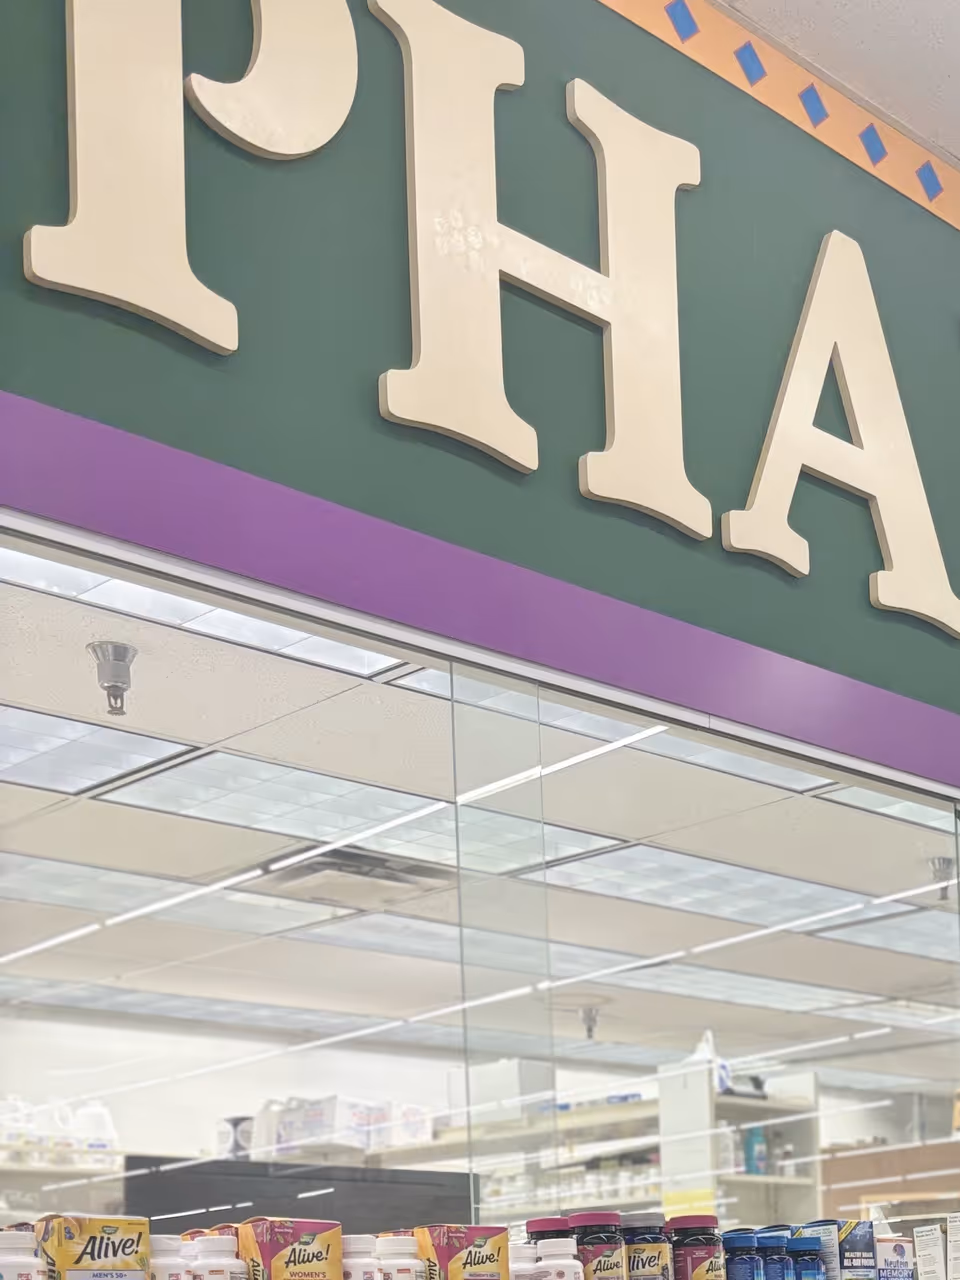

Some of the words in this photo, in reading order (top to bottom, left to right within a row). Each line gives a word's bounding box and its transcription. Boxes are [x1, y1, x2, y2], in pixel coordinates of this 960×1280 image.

[73, 1232, 143, 1265] Alive!
[285, 1243, 330, 1269] Alive!
[462, 1247, 501, 1269] Alive!
[289, 1271, 326, 1279] WOMEN'S
[879, 1269, 913, 1278] MEMORY
